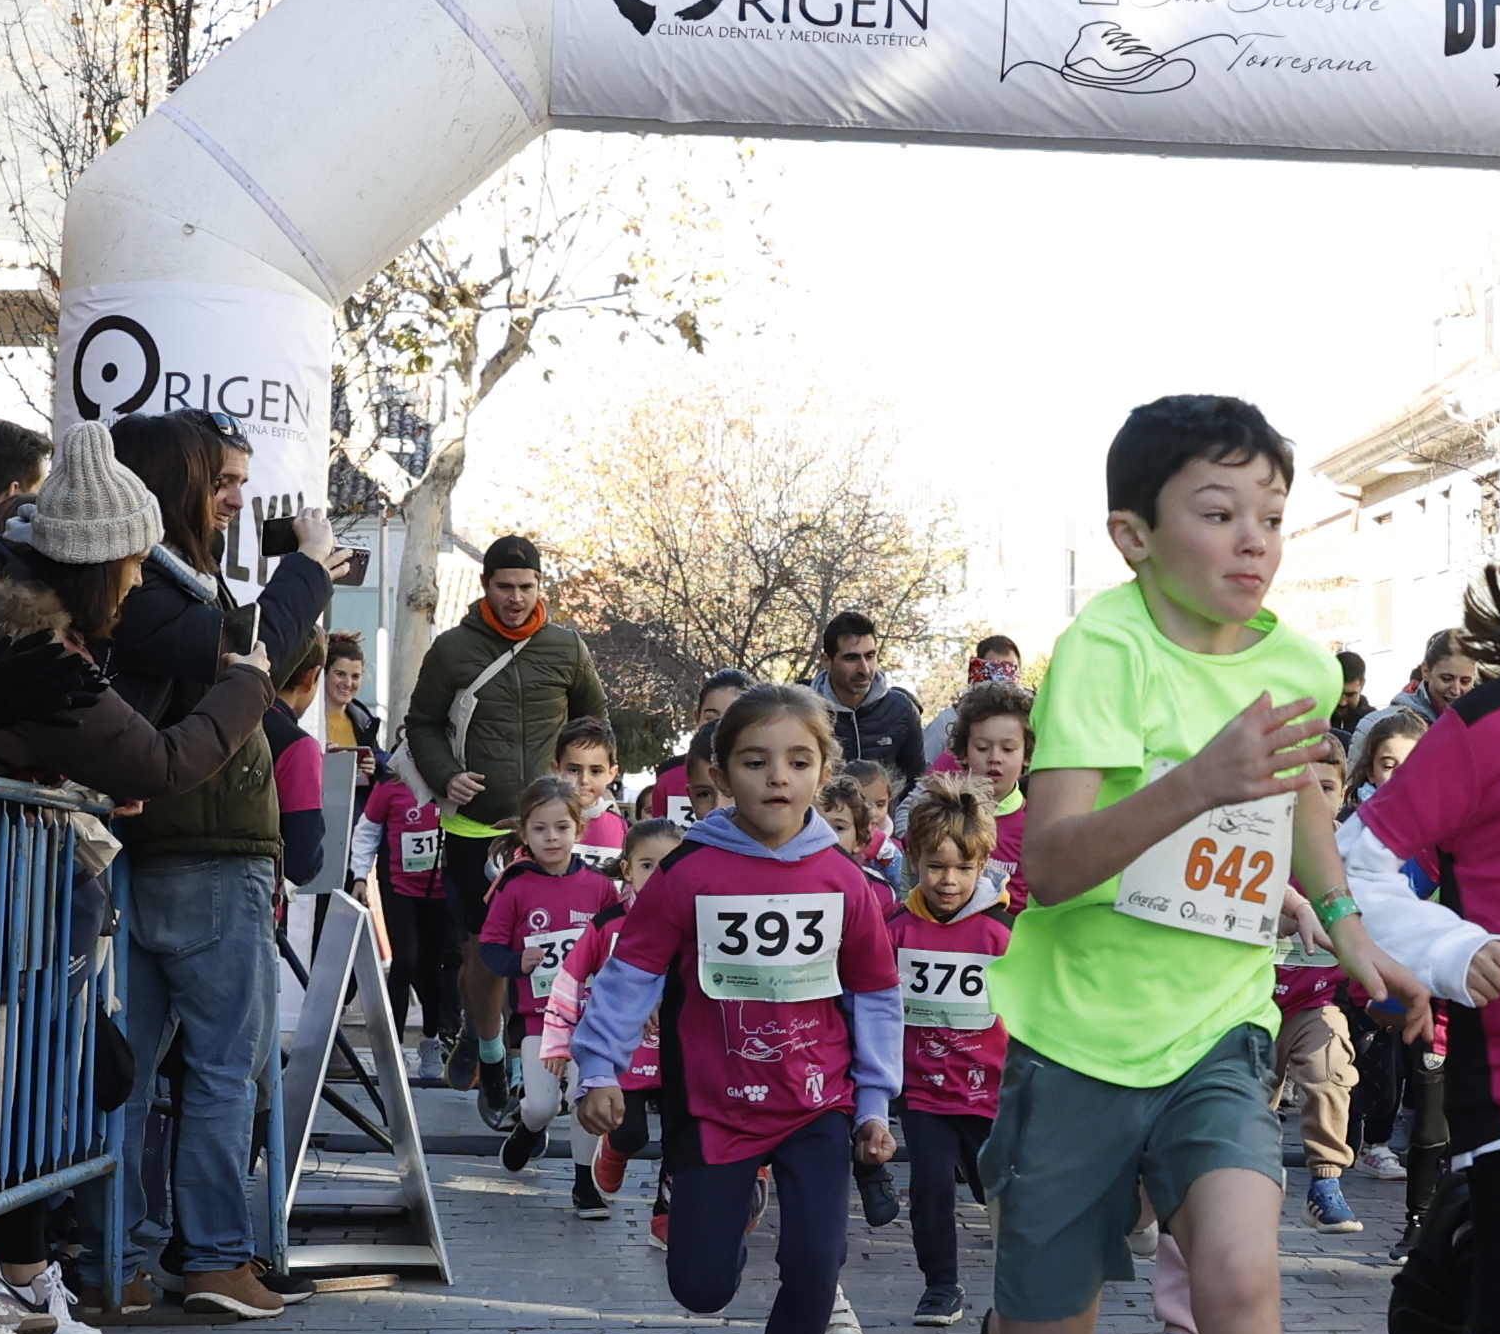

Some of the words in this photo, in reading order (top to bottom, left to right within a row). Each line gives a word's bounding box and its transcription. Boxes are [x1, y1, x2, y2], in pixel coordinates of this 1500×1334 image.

[657, 21, 714, 38] CLÍNICA
[718, 26, 773, 41] DENTAL
[777, 29, 787, 42] Y
[790, 30, 862, 45] MEDICINA
[866, 31, 928, 47] ESTÉTICA
[1226, 33, 1378, 73] Torresana
[73, 315, 310, 428] ORIGEN
[1185, 837, 1274, 905] 642
[717, 910, 824, 956] 393
[910, 960, 984, 997] 376
[727, 1086, 744, 1098] GM
